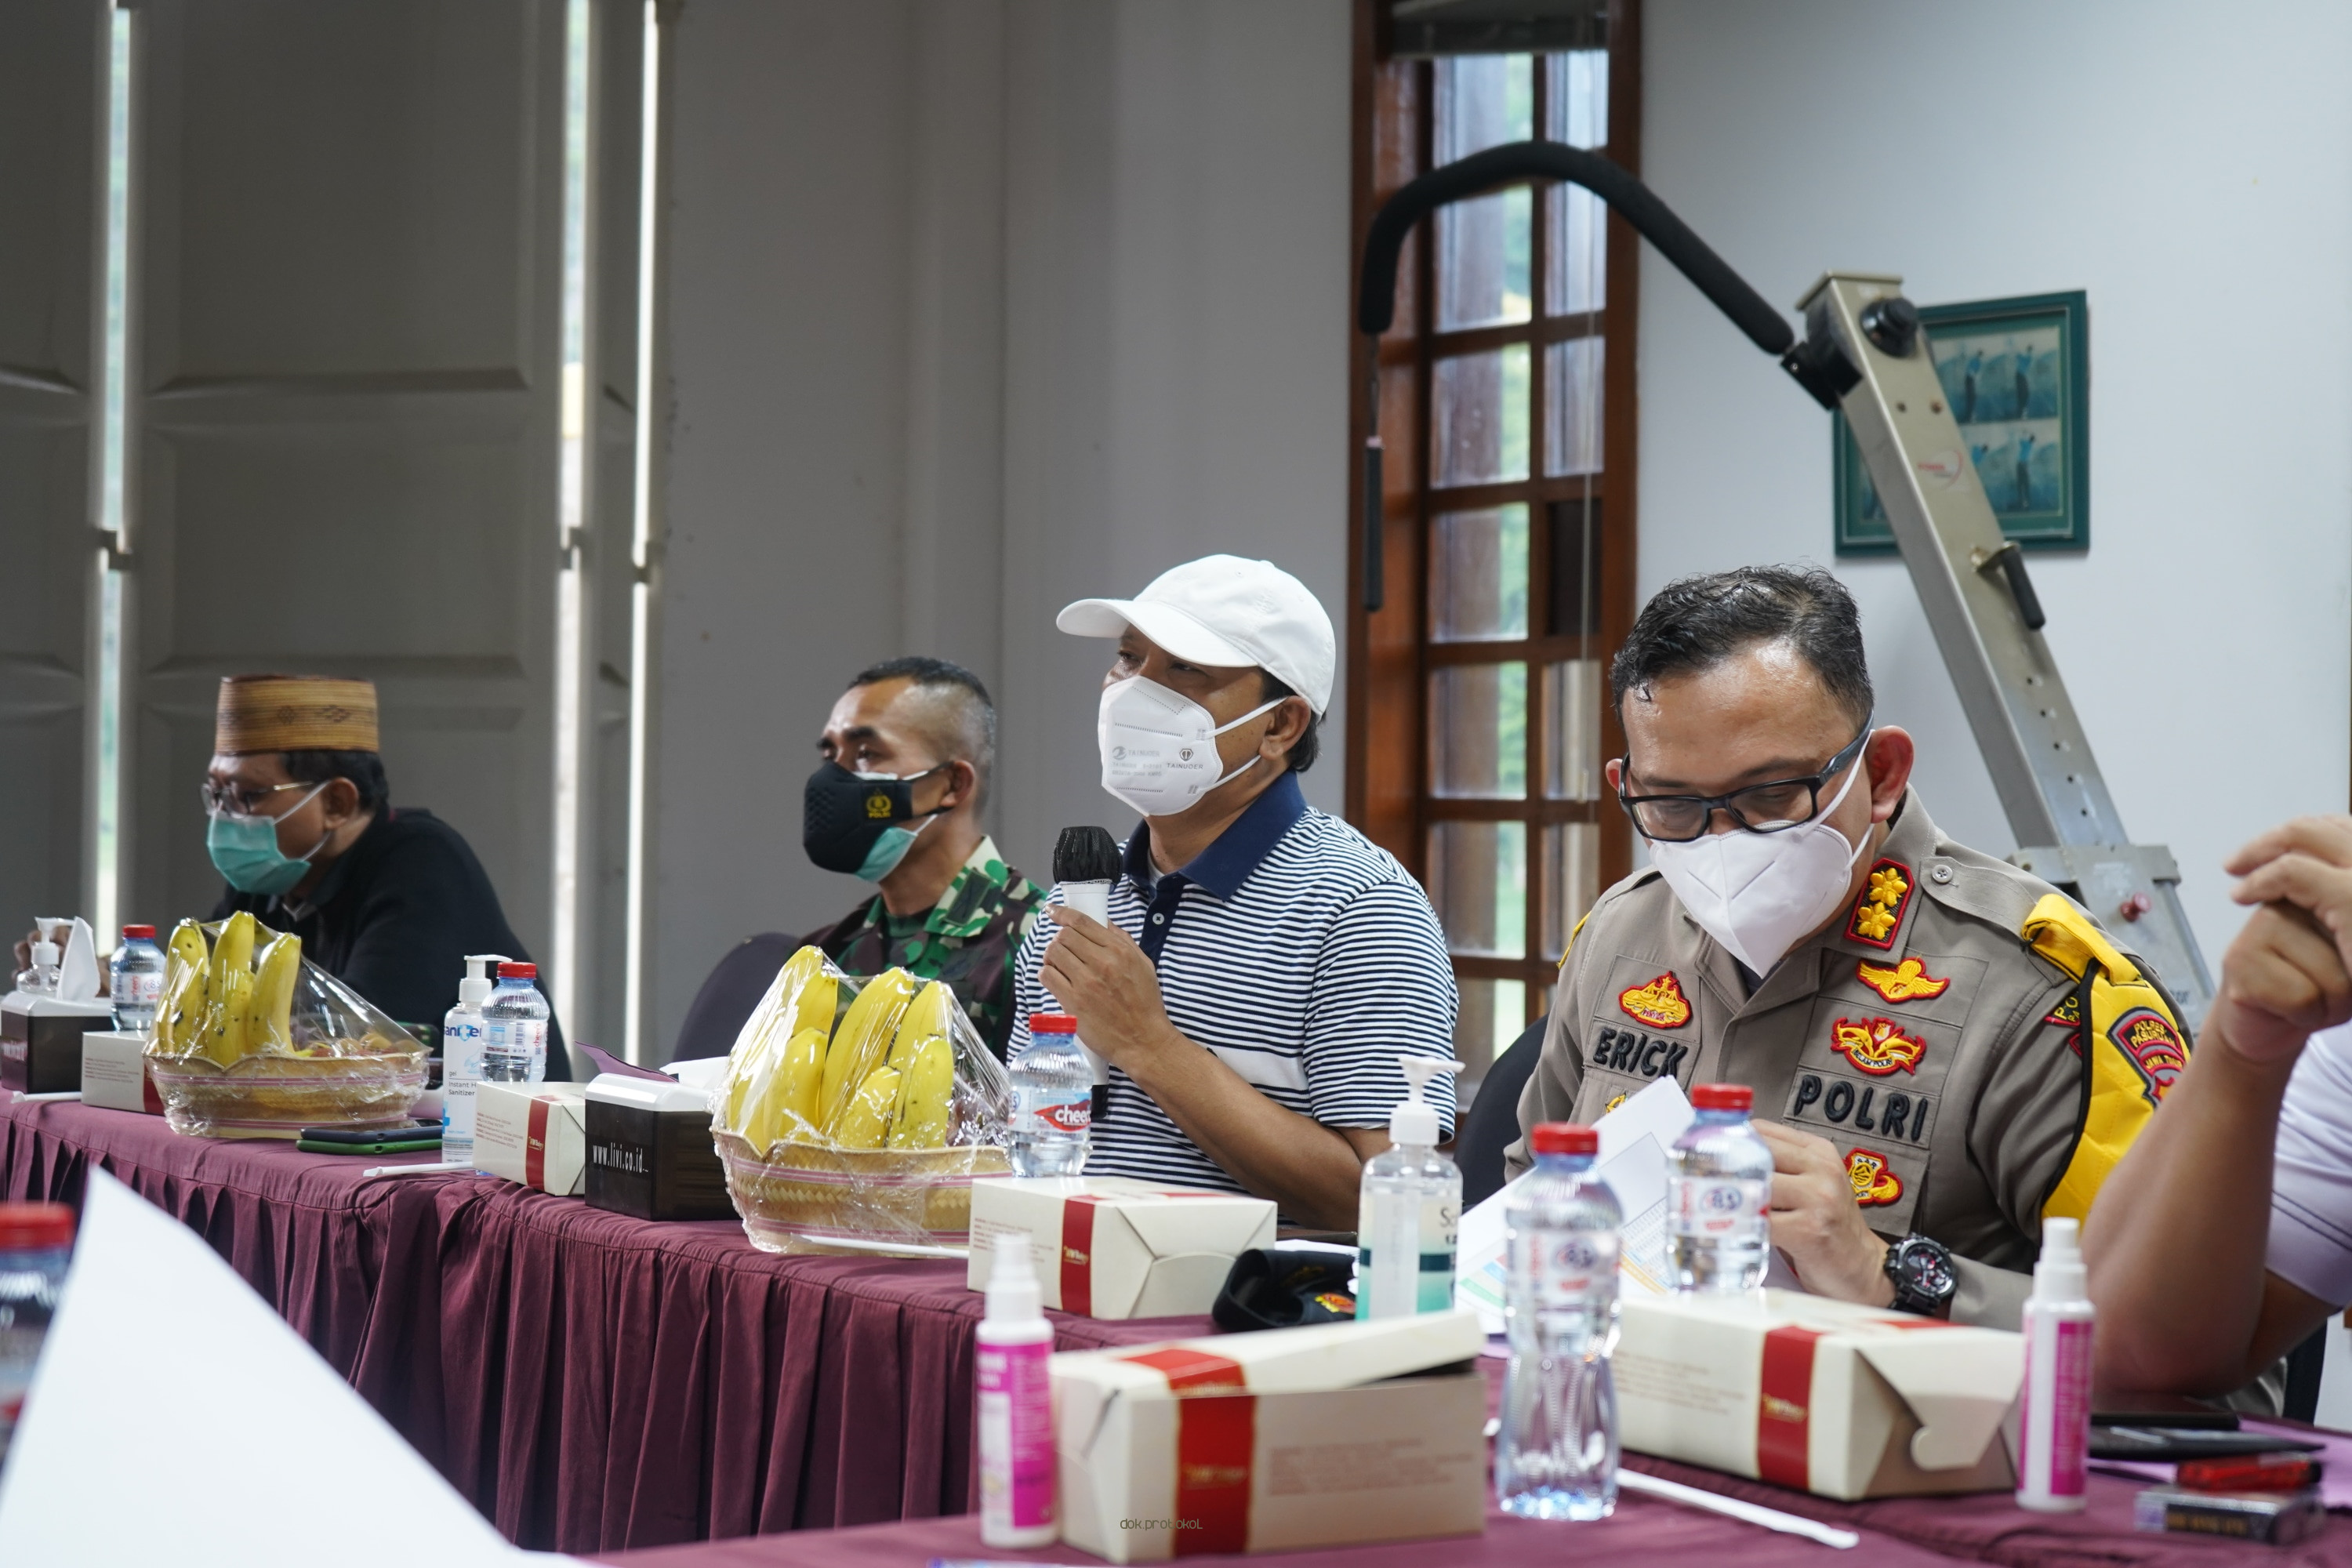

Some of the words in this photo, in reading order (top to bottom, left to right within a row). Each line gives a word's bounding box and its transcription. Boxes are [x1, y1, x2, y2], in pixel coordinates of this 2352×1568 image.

[1592, 1027, 1689, 1079] ERICK
[1054, 1105, 1092, 1123] cheer
[1793, 1074, 1929, 1143] POLRI
[593, 1142, 644, 1174] www.livi.co.id
